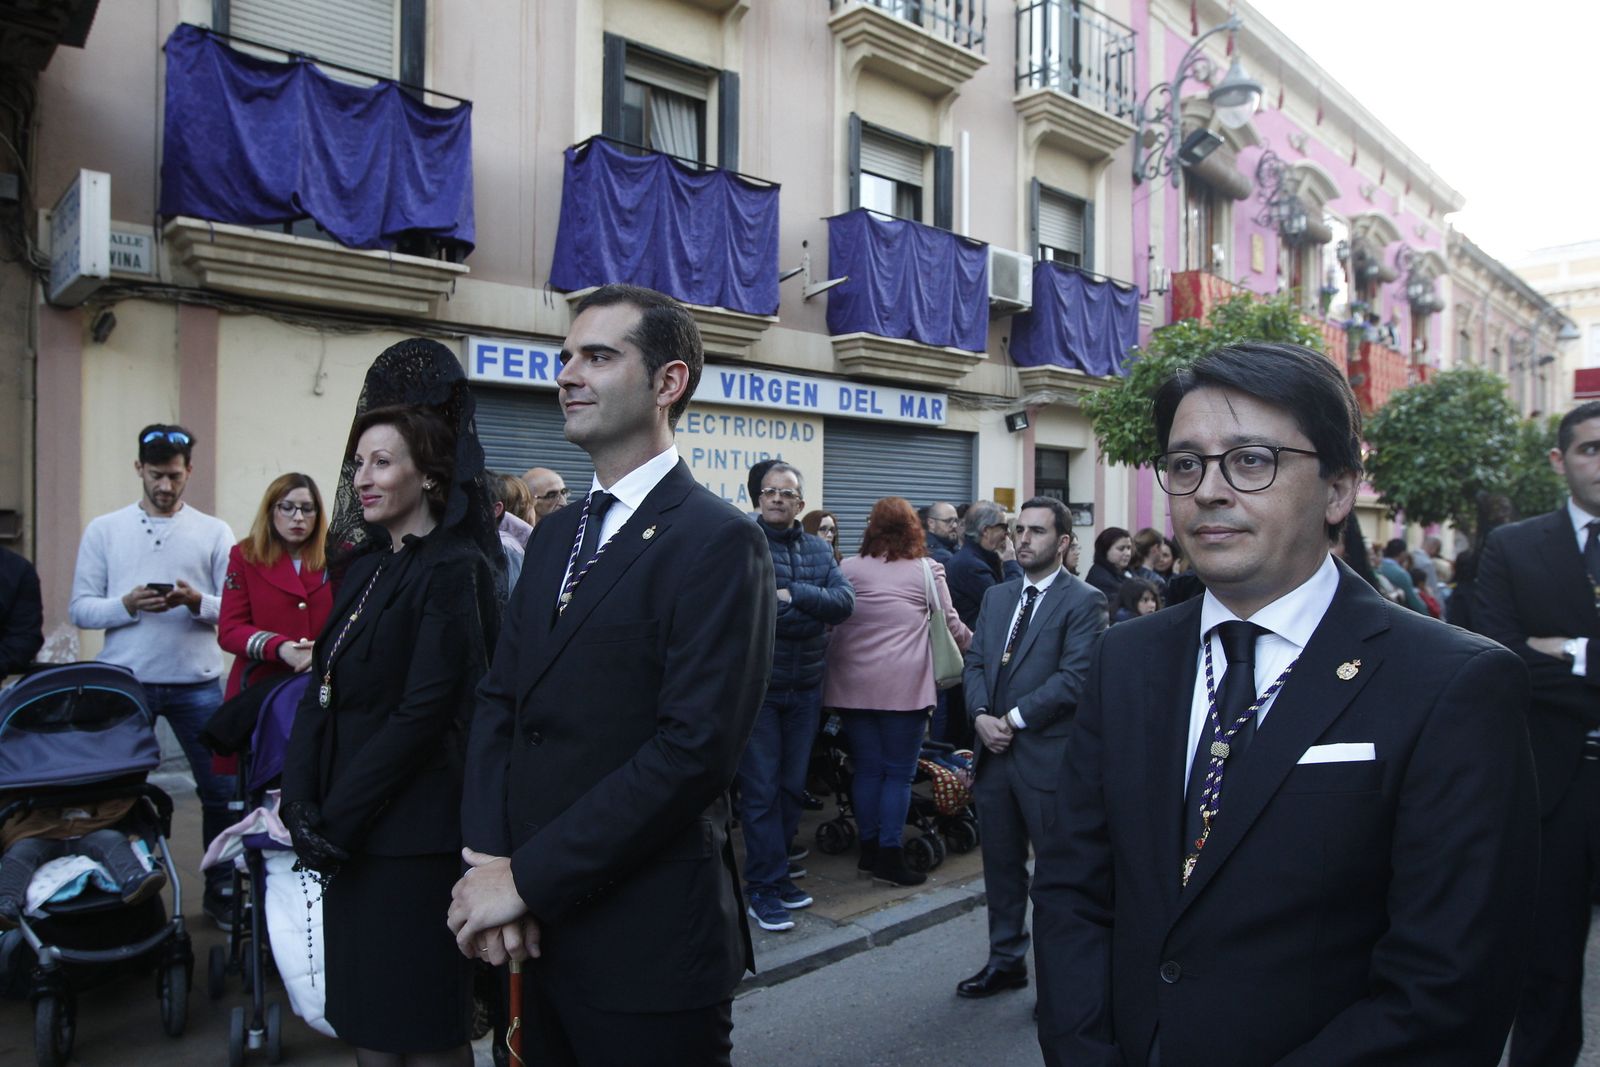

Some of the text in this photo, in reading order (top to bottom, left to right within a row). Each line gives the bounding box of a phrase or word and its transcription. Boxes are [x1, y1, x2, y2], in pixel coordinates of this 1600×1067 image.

[109, 234, 143, 248] ALLE
[109, 250, 142, 269] VINA
[721, 372, 818, 408] VIRGEN
[839, 387, 883, 414] DEL
[900, 394, 943, 421] MAR
[706, 482, 747, 503] LA
